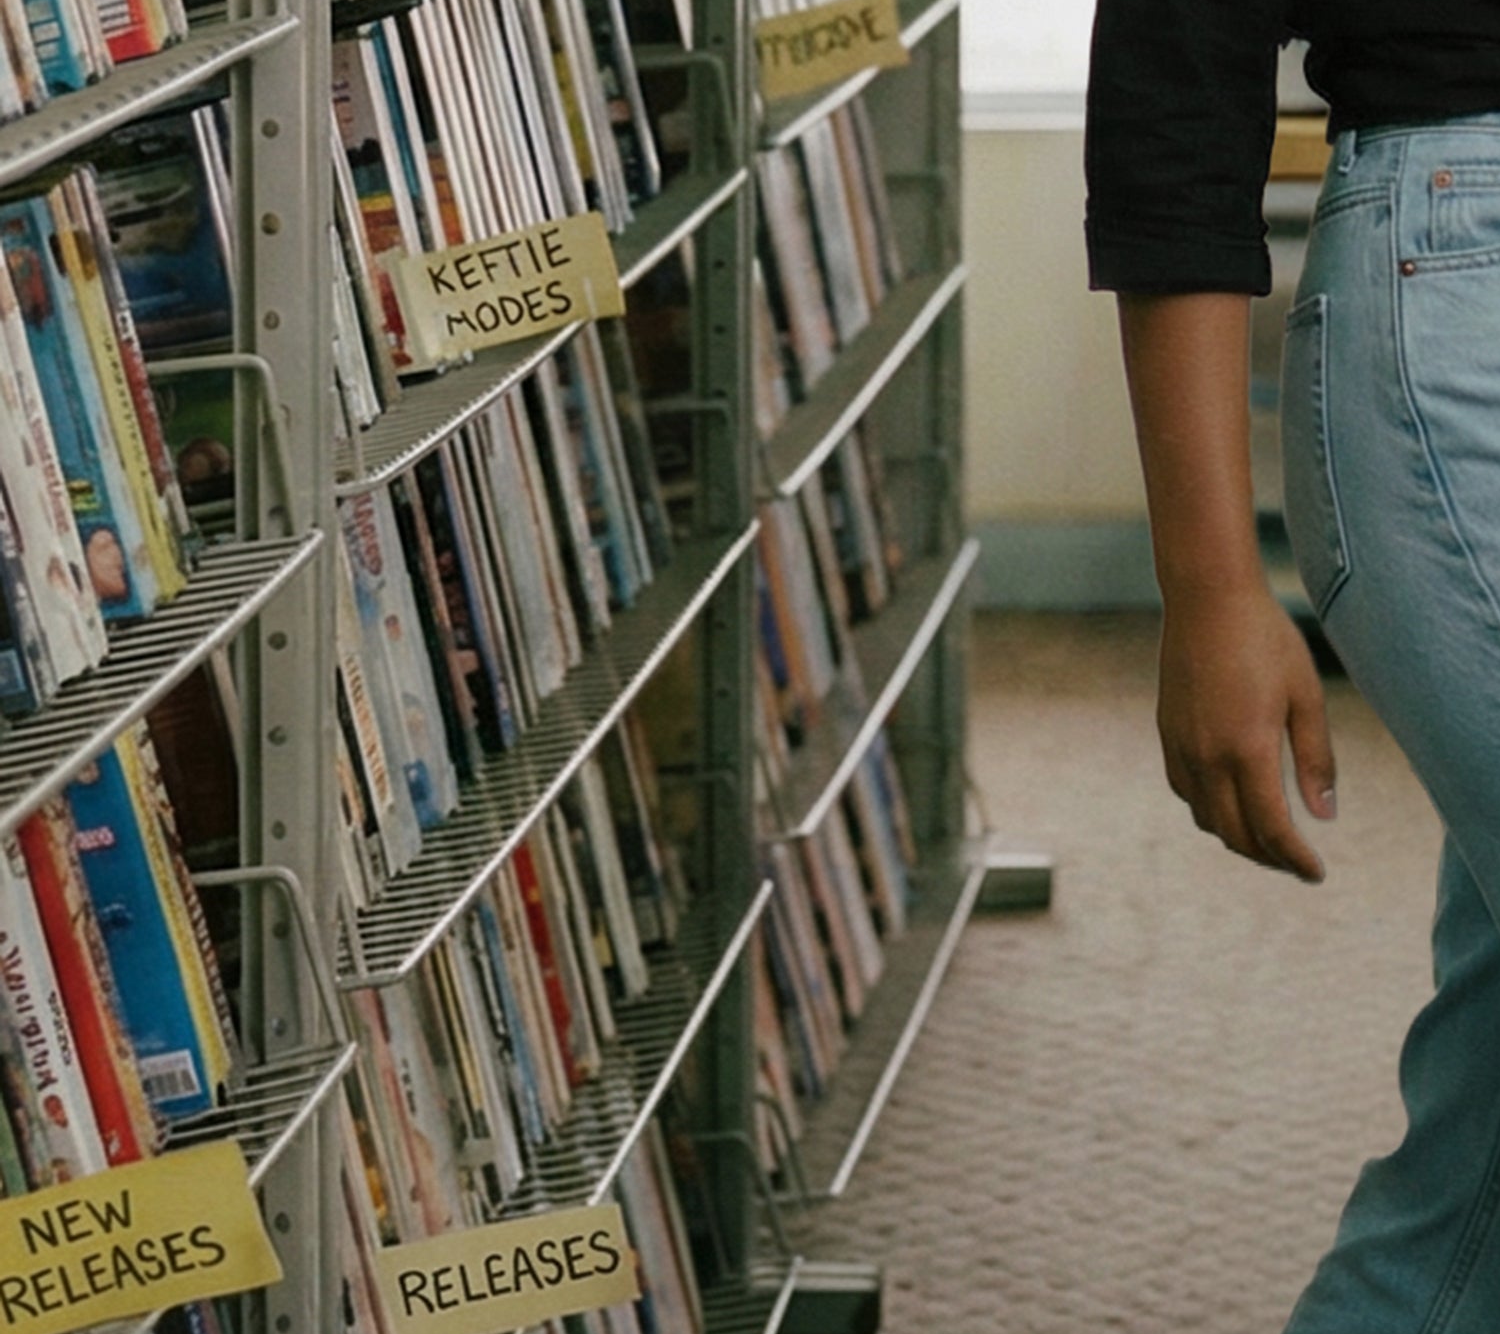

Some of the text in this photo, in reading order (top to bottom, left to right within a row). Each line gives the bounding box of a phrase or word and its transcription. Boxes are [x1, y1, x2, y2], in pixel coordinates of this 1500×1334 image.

[427, 228, 571, 295] KEFTIE
[19, 1189, 131, 1255] NEW
[0, 1225, 226, 1325] RELEASES
[398, 1230, 620, 1317] RELEASES
